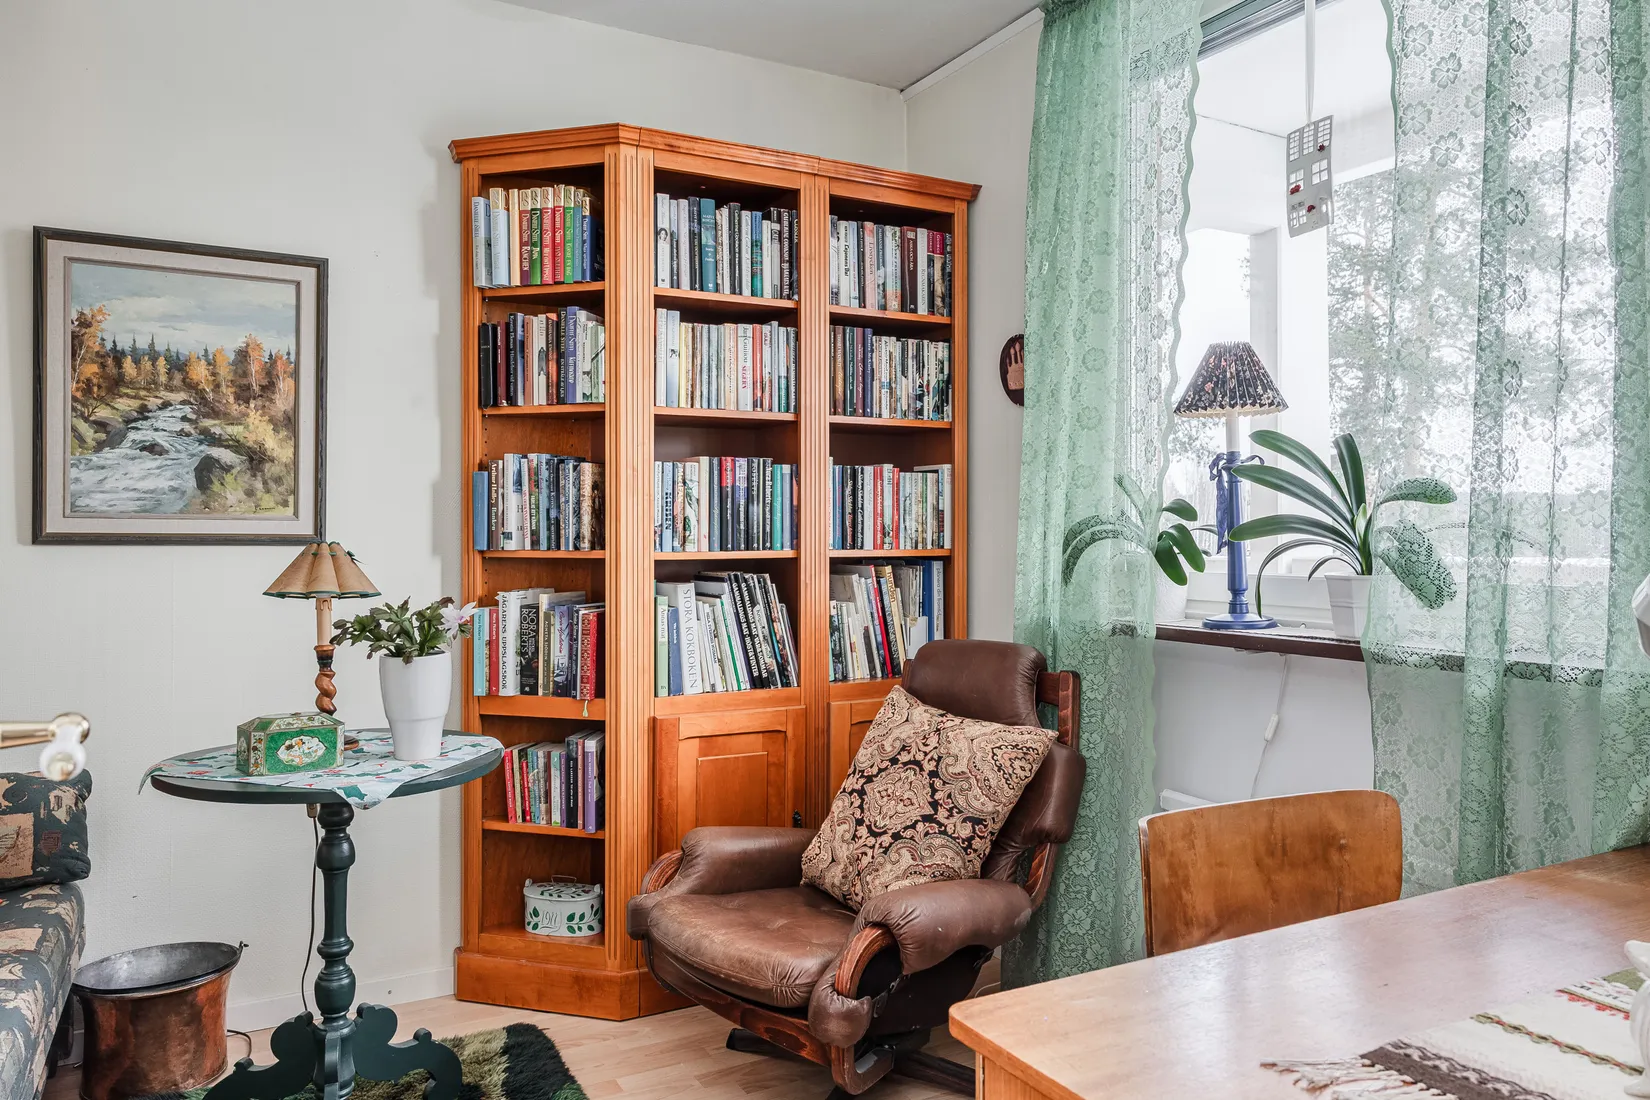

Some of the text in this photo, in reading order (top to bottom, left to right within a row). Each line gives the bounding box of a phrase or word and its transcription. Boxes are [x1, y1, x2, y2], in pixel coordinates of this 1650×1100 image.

[732, 582, 745, 623] GAMMALDAGS
[740, 623, 749, 635] MAT
[741, 582, 754, 623] GAMMALDAGS
[749, 622, 758, 635] MAT
[887, 572, 897, 603] hunden
[521, 608, 529, 653] ROBERTS
[528, 608, 537, 637] NORA
[682, 589, 698, 688] STORA KOKBOKEN
